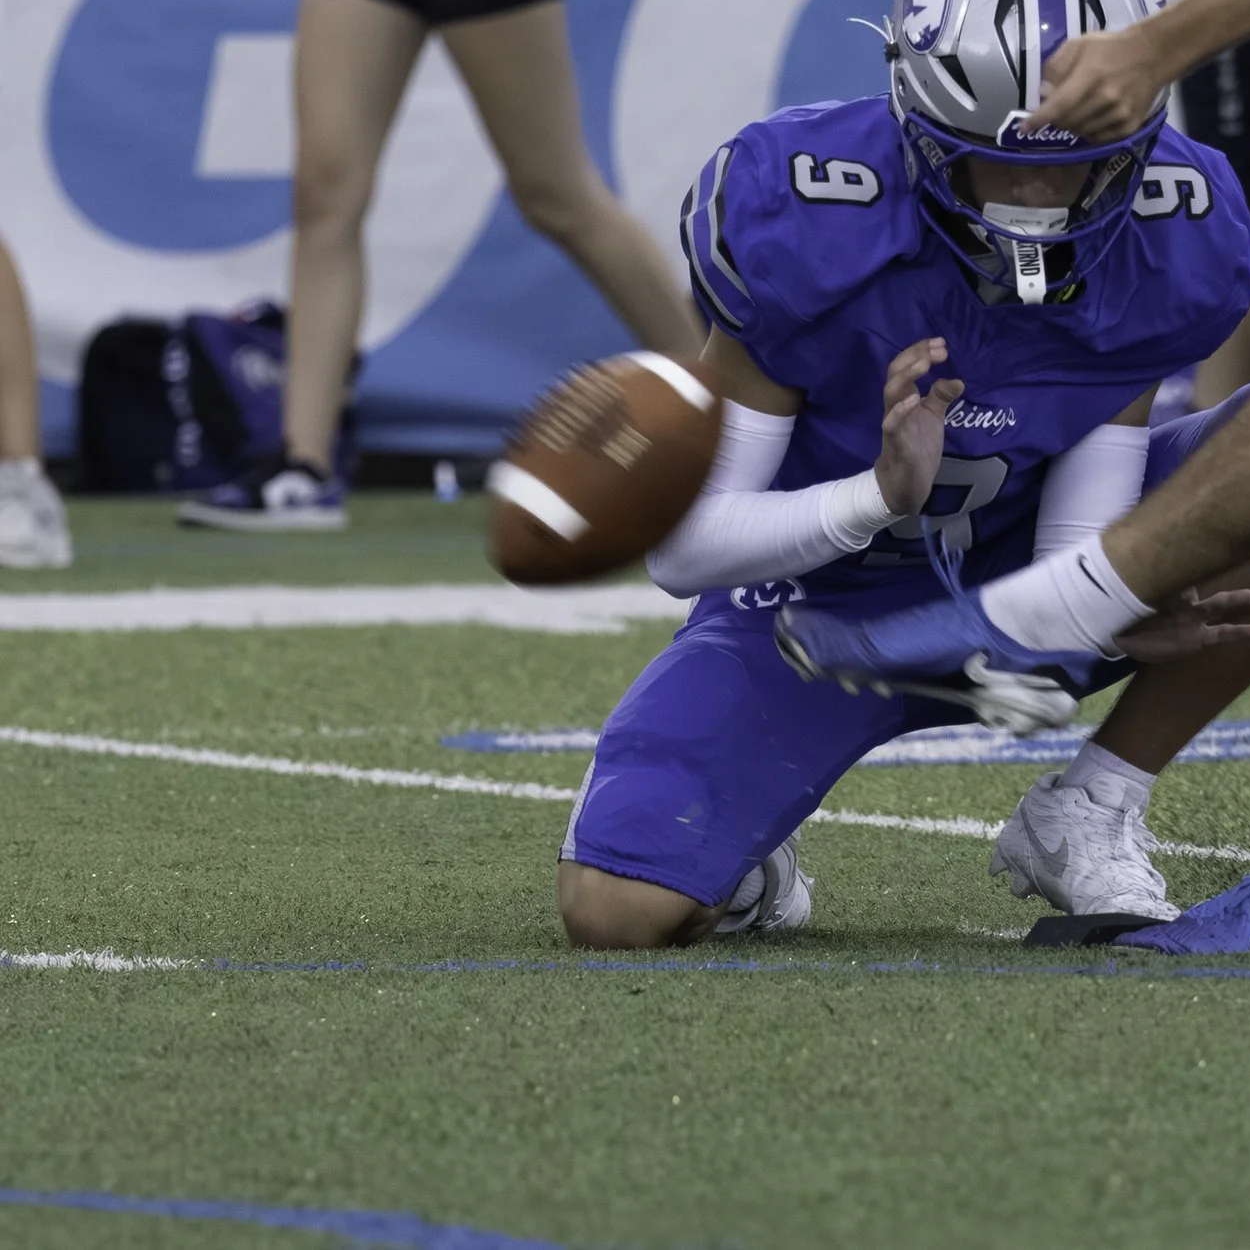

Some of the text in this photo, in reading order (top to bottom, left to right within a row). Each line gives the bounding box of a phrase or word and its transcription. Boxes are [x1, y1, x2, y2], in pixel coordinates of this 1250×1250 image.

[788, 150, 884, 209] 9
[1130, 161, 1214, 222] 9
[943, 399, 1017, 436] kings
